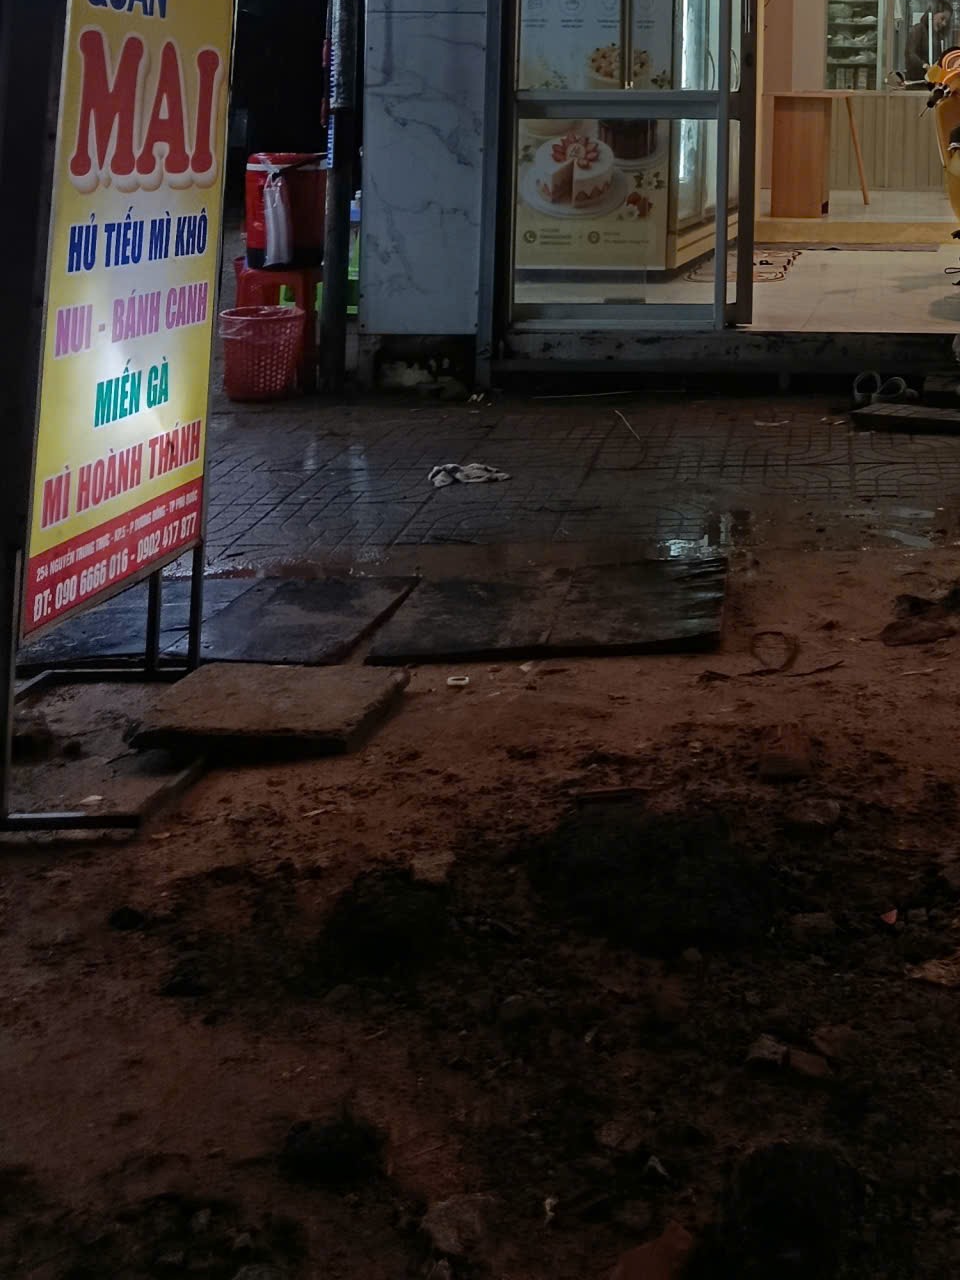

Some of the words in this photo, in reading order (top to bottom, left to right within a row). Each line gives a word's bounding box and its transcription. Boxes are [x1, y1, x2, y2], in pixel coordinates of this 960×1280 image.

[69, 29, 221, 180] MAI
[67, 213, 98, 273] HỦ
[104, 206, 144, 267] TIẾU
[148, 210, 170, 260] MÌ
[175, 207, 209, 256] KHÔ
[55, 303, 93, 358] NUI
[111, 288, 162, 343] BÁNH
[165, 281, 209, 330] CANH
[94, 358, 142, 428] MIẾN
[146, 356, 170, 410] GÀ
[41, 464, 72, 531] MÌ
[76, 447, 144, 514] HOÀNH
[149, 421, 201, 480] THÁNH
[33, 588, 52, 623] ĐT:
[55, 574, 77, 610] 090
[79, 559, 107, 596] 6666
[109, 547, 129, 580] 016
[137, 529, 161, 563] 0902
[162, 519, 179, 548] 417
[180, 511, 198, 540] 877
